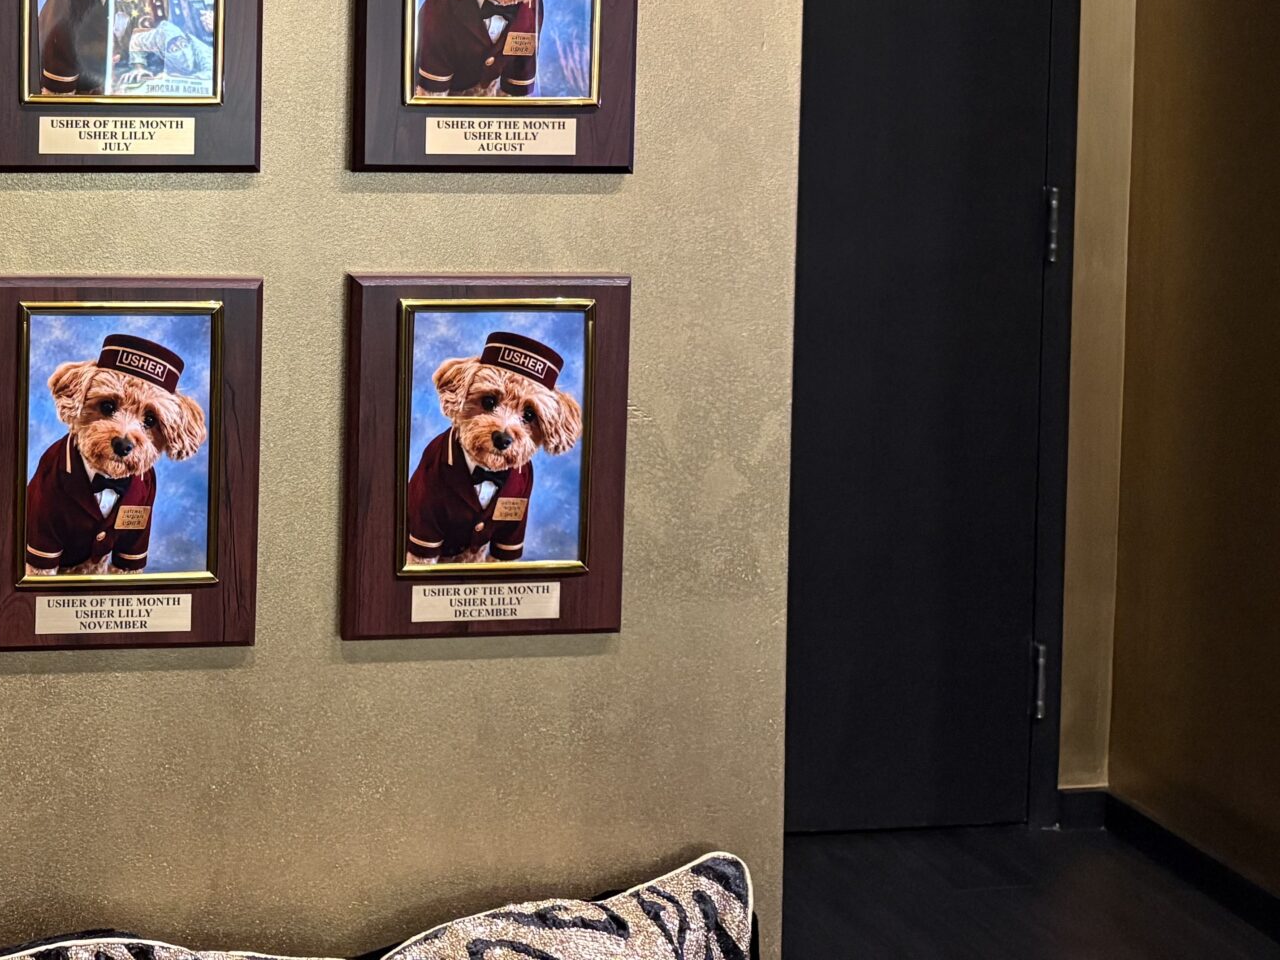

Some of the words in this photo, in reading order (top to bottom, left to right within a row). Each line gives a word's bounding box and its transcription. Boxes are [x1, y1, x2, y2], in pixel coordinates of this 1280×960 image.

[50, 119, 90, 128] USHER
[92, 119, 109, 128] OF
[111, 120, 136, 128] THE
[139, 120, 183, 128] MONTH
[437, 120, 475, 129] USHER
[477, 120, 493, 129] OF
[496, 120, 519, 129] THE
[522, 120, 565, 129] MONTH
[78, 130, 118, 139] USHER
[121, 131, 155, 140] LILLY
[464, 131, 502, 140] USHER
[505, 131, 538, 140] LILLY
[102, 142, 131, 150] JULY
[478, 142, 524, 151] AUGUST
[122, 352, 164, 377] USHER
[504, 349, 544, 374] USHER
[423, 587, 460, 596] USHER
[463, 587, 479, 596] OF
[481, 586, 504, 595] THE
[507, 585, 549, 594] MONTH
[47, 598, 87, 608] USHER
[89, 598, 106, 607] OF
[108, 597, 133, 607] THE
[135, 597, 180, 606] MONTH
[449, 597, 487, 607] USHER
[490, 596, 522, 606] LILLY
[75, 609, 114, 618] USHER
[117, 608, 152, 618] LILLY
[454, 607, 517, 617] DECEMBER
[79, 620, 147, 630] NOVEMBER
